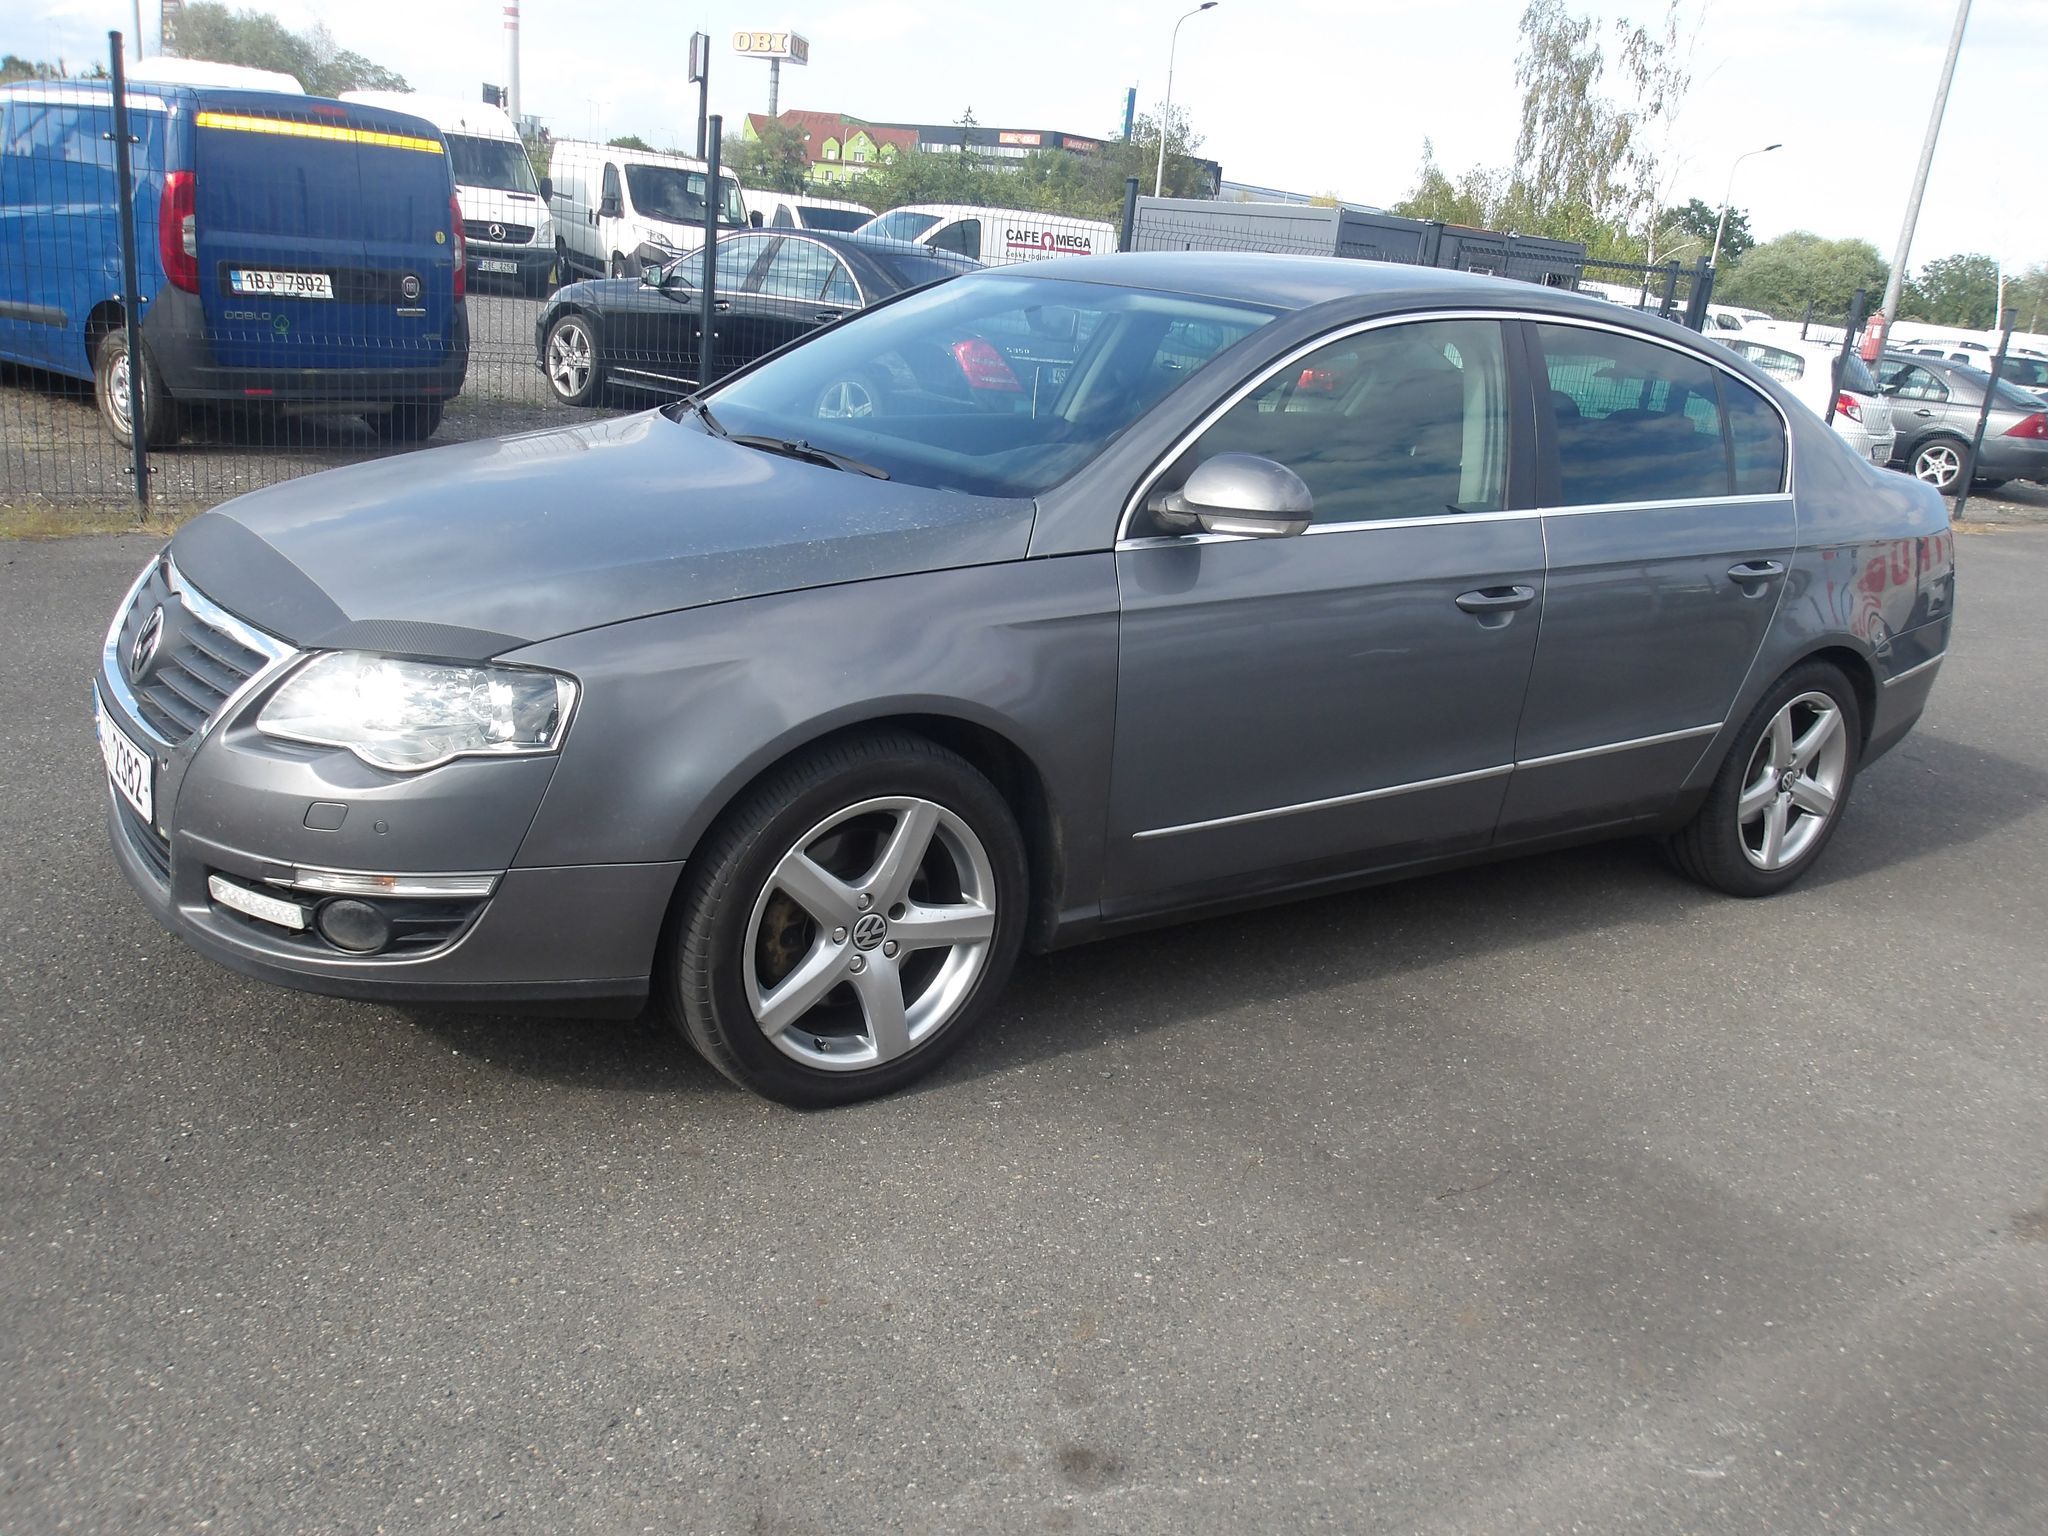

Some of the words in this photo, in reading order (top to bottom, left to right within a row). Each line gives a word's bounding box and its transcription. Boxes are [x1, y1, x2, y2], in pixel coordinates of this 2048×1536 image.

[733, 32, 787, 53] OBI
[1006, 229, 1039, 244] CAFE
[246, 273, 275, 290] 1BJ
[286, 274, 325, 292] 7902
[113, 733, 143, 807] 2382
